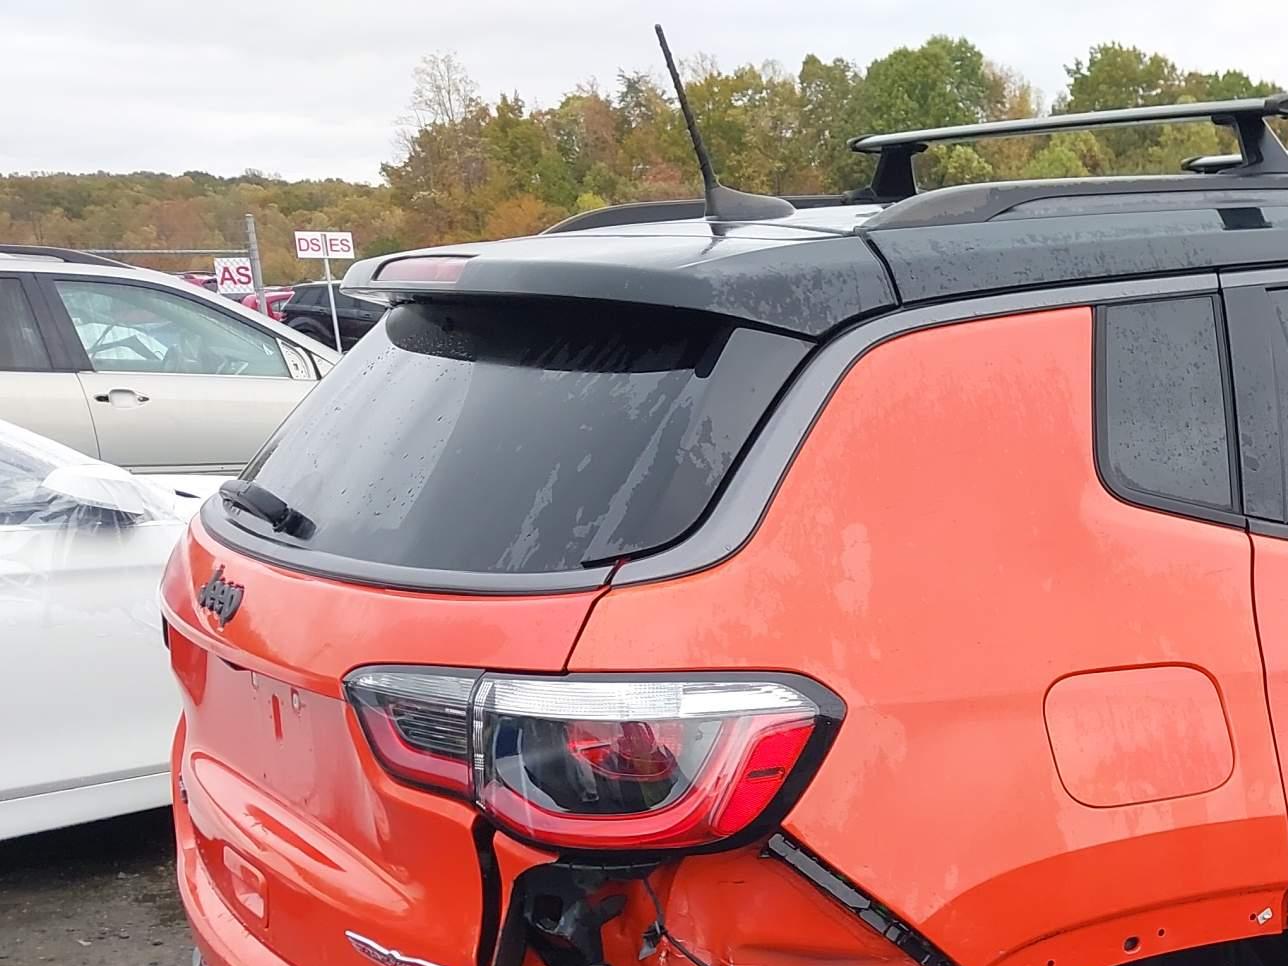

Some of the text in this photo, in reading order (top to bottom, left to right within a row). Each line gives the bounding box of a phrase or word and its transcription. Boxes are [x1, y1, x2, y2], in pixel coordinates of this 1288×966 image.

[297, 237, 351, 252] DS ES
[220, 266, 252, 286] AS
[197, 564, 245, 627] Jeep
